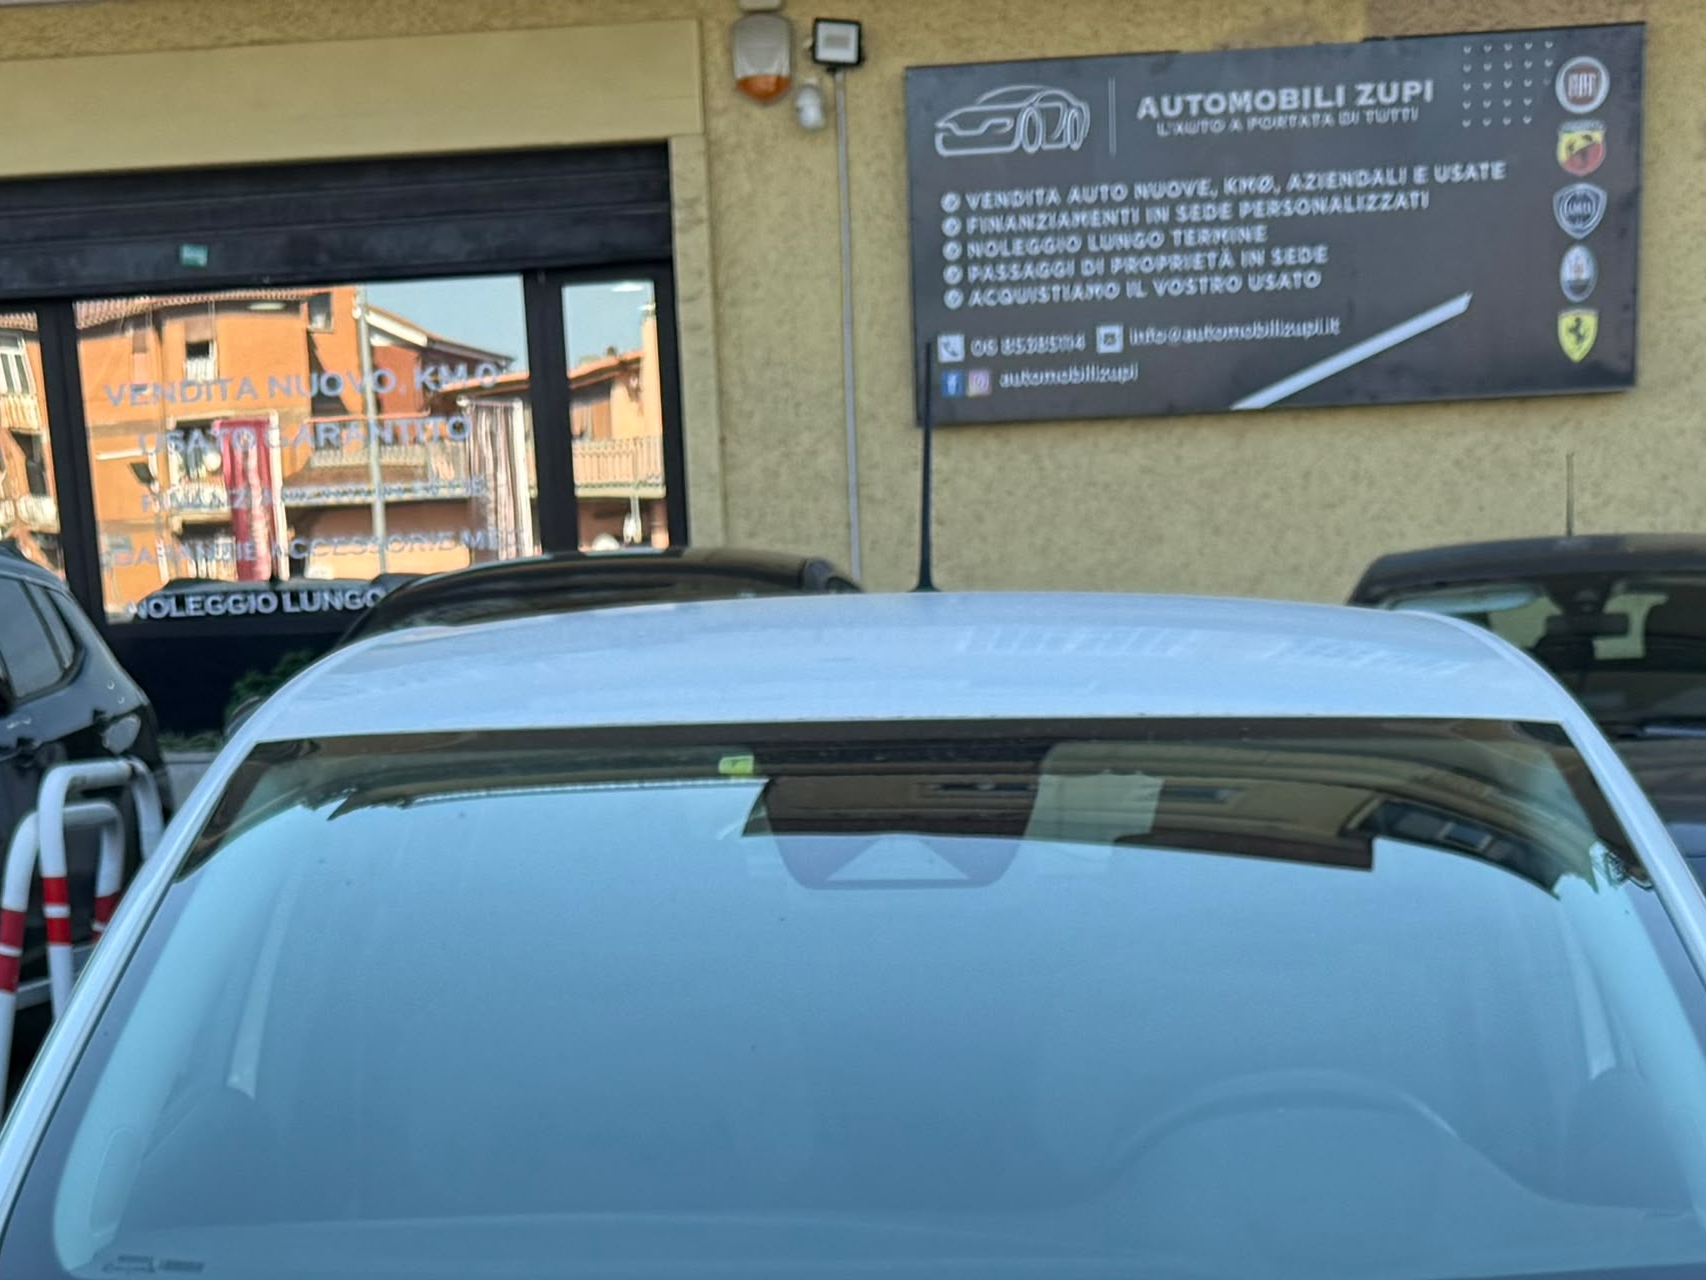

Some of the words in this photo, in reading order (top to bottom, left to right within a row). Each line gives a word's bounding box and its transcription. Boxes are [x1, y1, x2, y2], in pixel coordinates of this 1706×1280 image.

[1137, 84, 1344, 120] AUTOMOBILI
[1354, 79, 1435, 106] ZUPI
[1156, 117, 1225, 137] L'AUTO
[1229, 117, 1244, 132] A
[1246, 110, 1335, 131] PORTATA
[1338, 110, 1359, 126] DI
[1363, 106, 1420, 123] TUTTI
[965, 187, 1062, 211] VENDITA
[1067, 183, 1129, 204] AUTO
[1133, 178, 1219, 200] NUOVE,
[1286, 166, 1408, 192] AZIENDALI
[1412, 164, 1430, 184] E
[1433, 160, 1507, 183] USATE
[966, 206, 1140, 235] FINANZIAMENTI
[1145, 205, 1170, 224] IN
[1175, 201, 1233, 223] SEDE
[1239, 190, 1430, 220] PERSONALIZZATI
[966, 234, 1083, 259] NOLEGGIO
[1086, 229, 1166, 252] LUNGO
[1170, 224, 1269, 247] TERMINE
[967, 258, 1075, 283] PASSAGGI
[1080, 258, 1105, 277] DI
[1240, 248, 1266, 268] IN
[1269, 244, 1329, 267] SEDE
[967, 281, 1122, 307] ACQUISTIAMO
[1125, 279, 1148, 298] IL
[1152, 273, 1243, 298] VOSTRO
[1247, 270, 1322, 293] USATO
[104, 376, 259, 408] VENDITA
[138, 424, 260, 458] USATO
[266, 415, 471, 448] GARANTITO
[127, 591, 279, 620] NOLEGGIO
